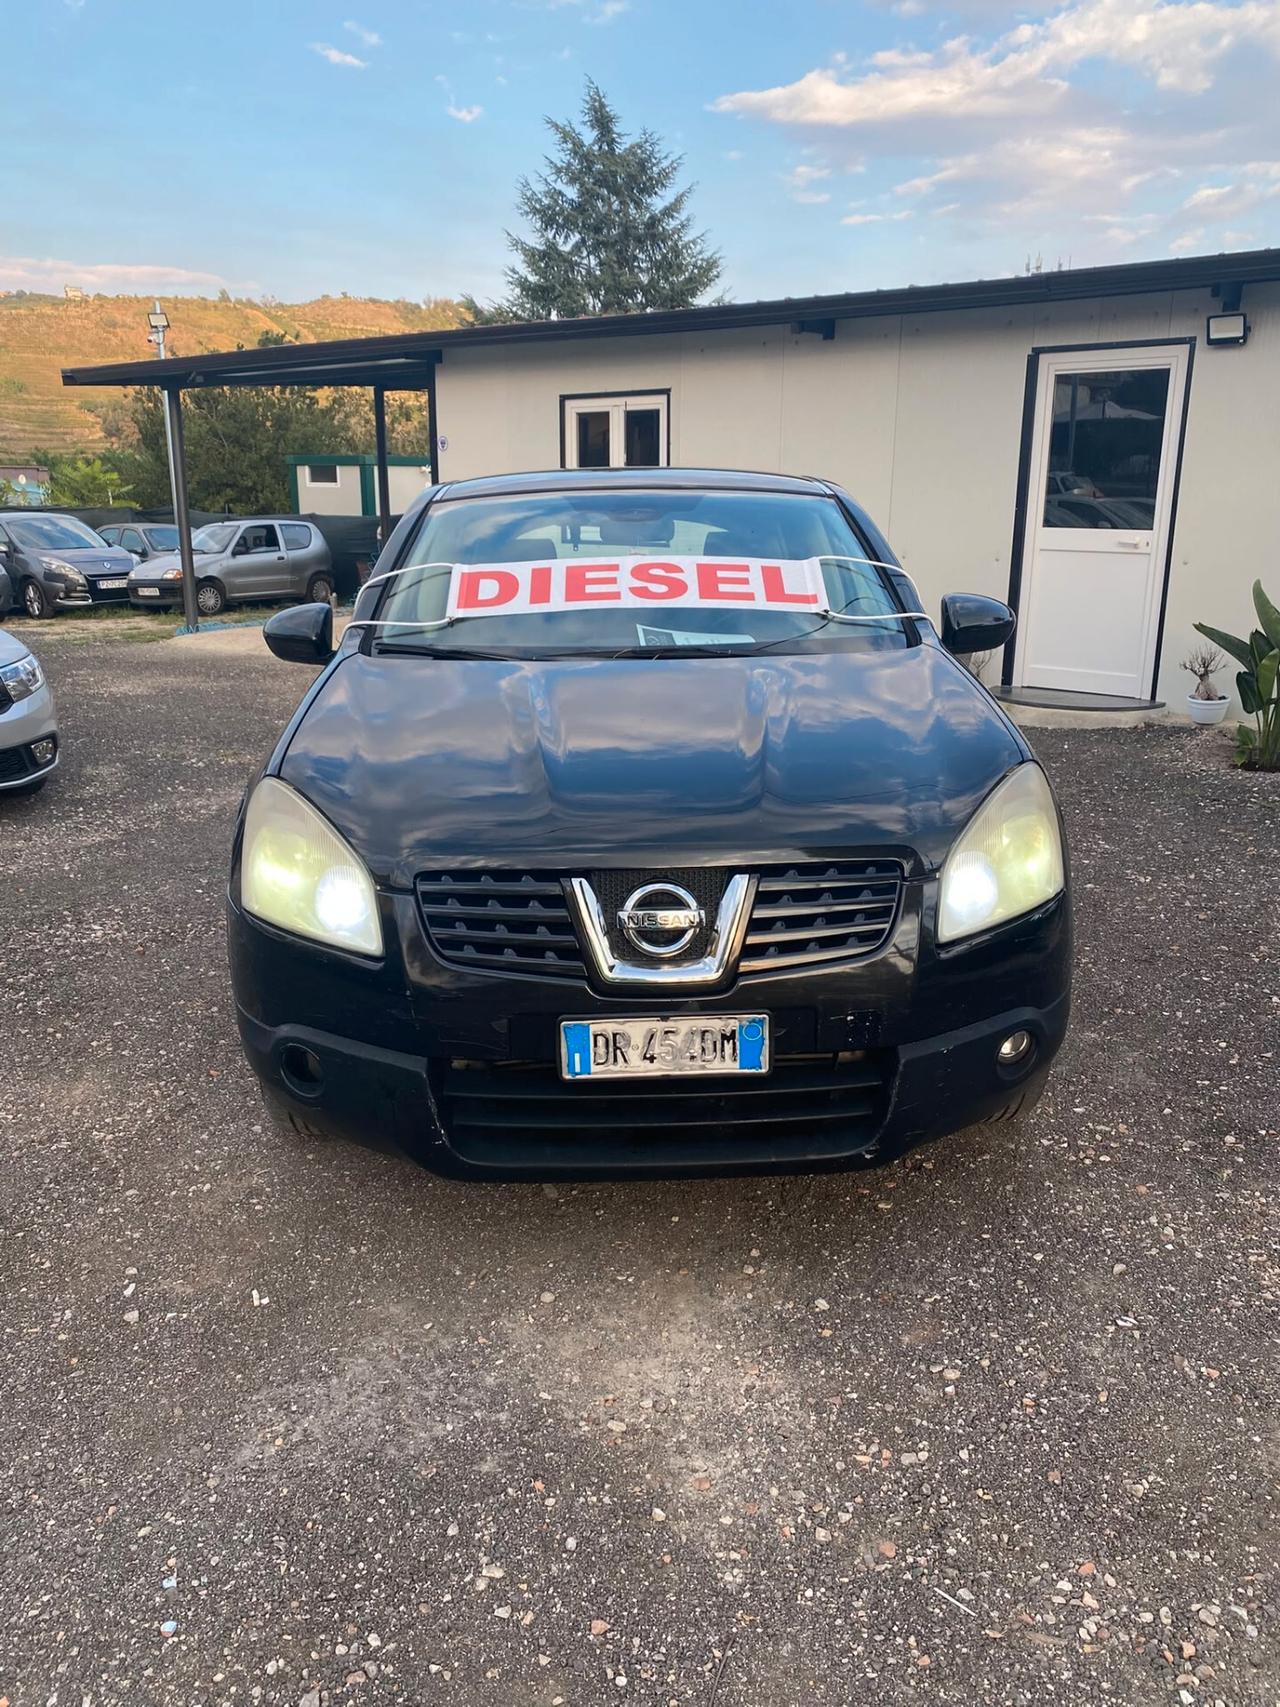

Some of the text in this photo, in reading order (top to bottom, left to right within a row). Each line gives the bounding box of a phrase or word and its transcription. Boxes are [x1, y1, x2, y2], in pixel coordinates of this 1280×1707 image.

[457, 562, 819, 609] DIESEL
[627, 912, 697, 926] NISSAN
[593, 1031, 631, 1066] DR
